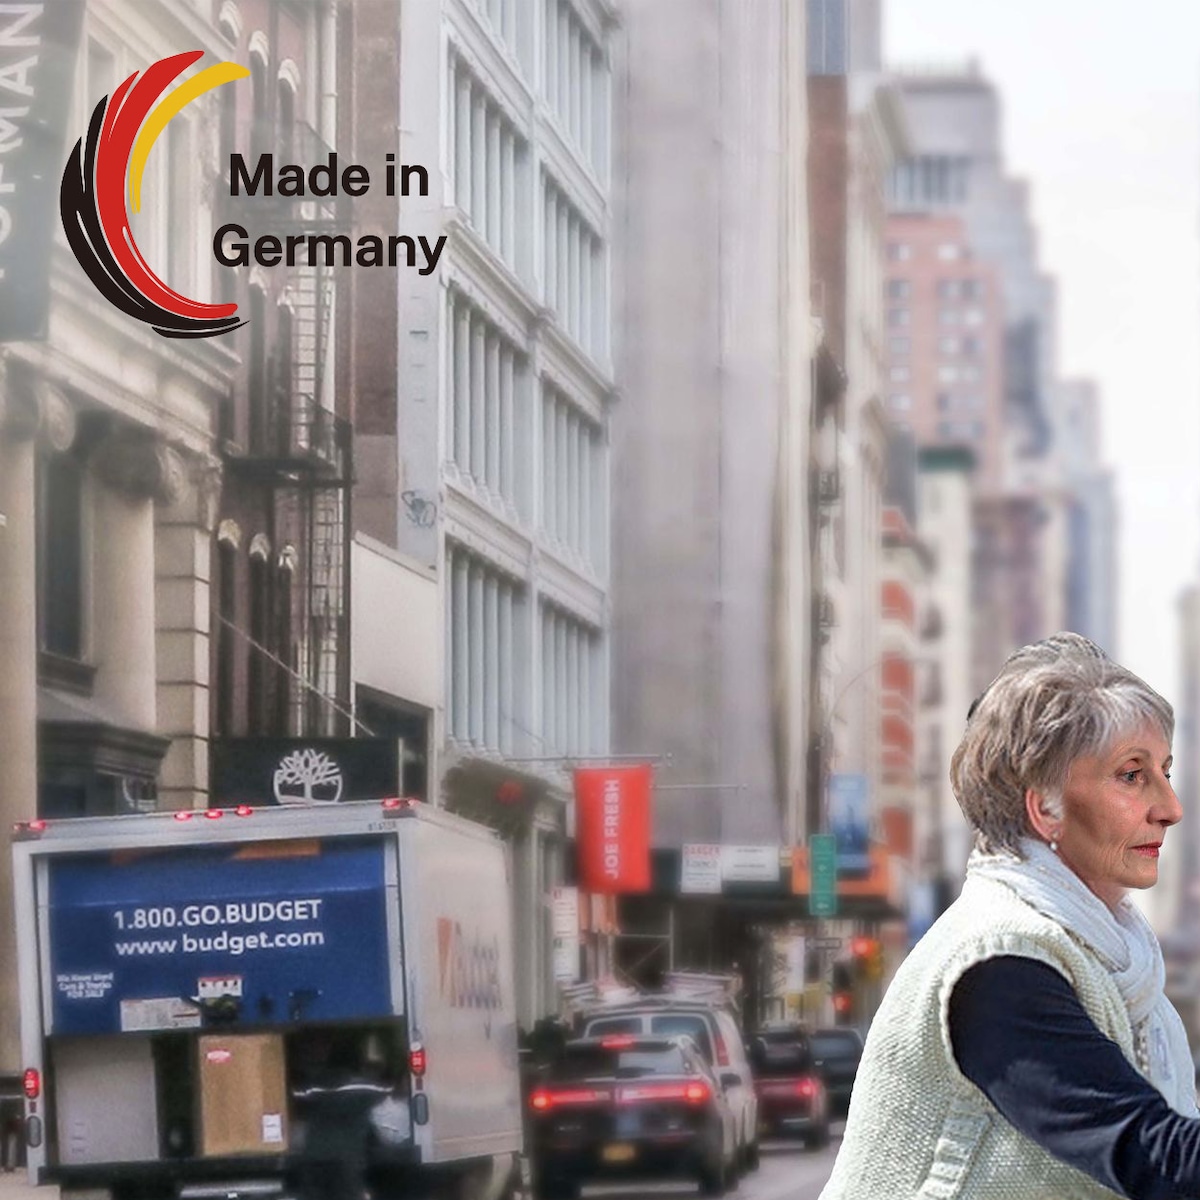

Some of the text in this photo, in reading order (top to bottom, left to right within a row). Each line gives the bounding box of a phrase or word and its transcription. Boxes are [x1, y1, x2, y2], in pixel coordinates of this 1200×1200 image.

[604, 779, 620, 880] JOE FRESH
[113, 899, 323, 931] 1.800.GO.BUDGET
